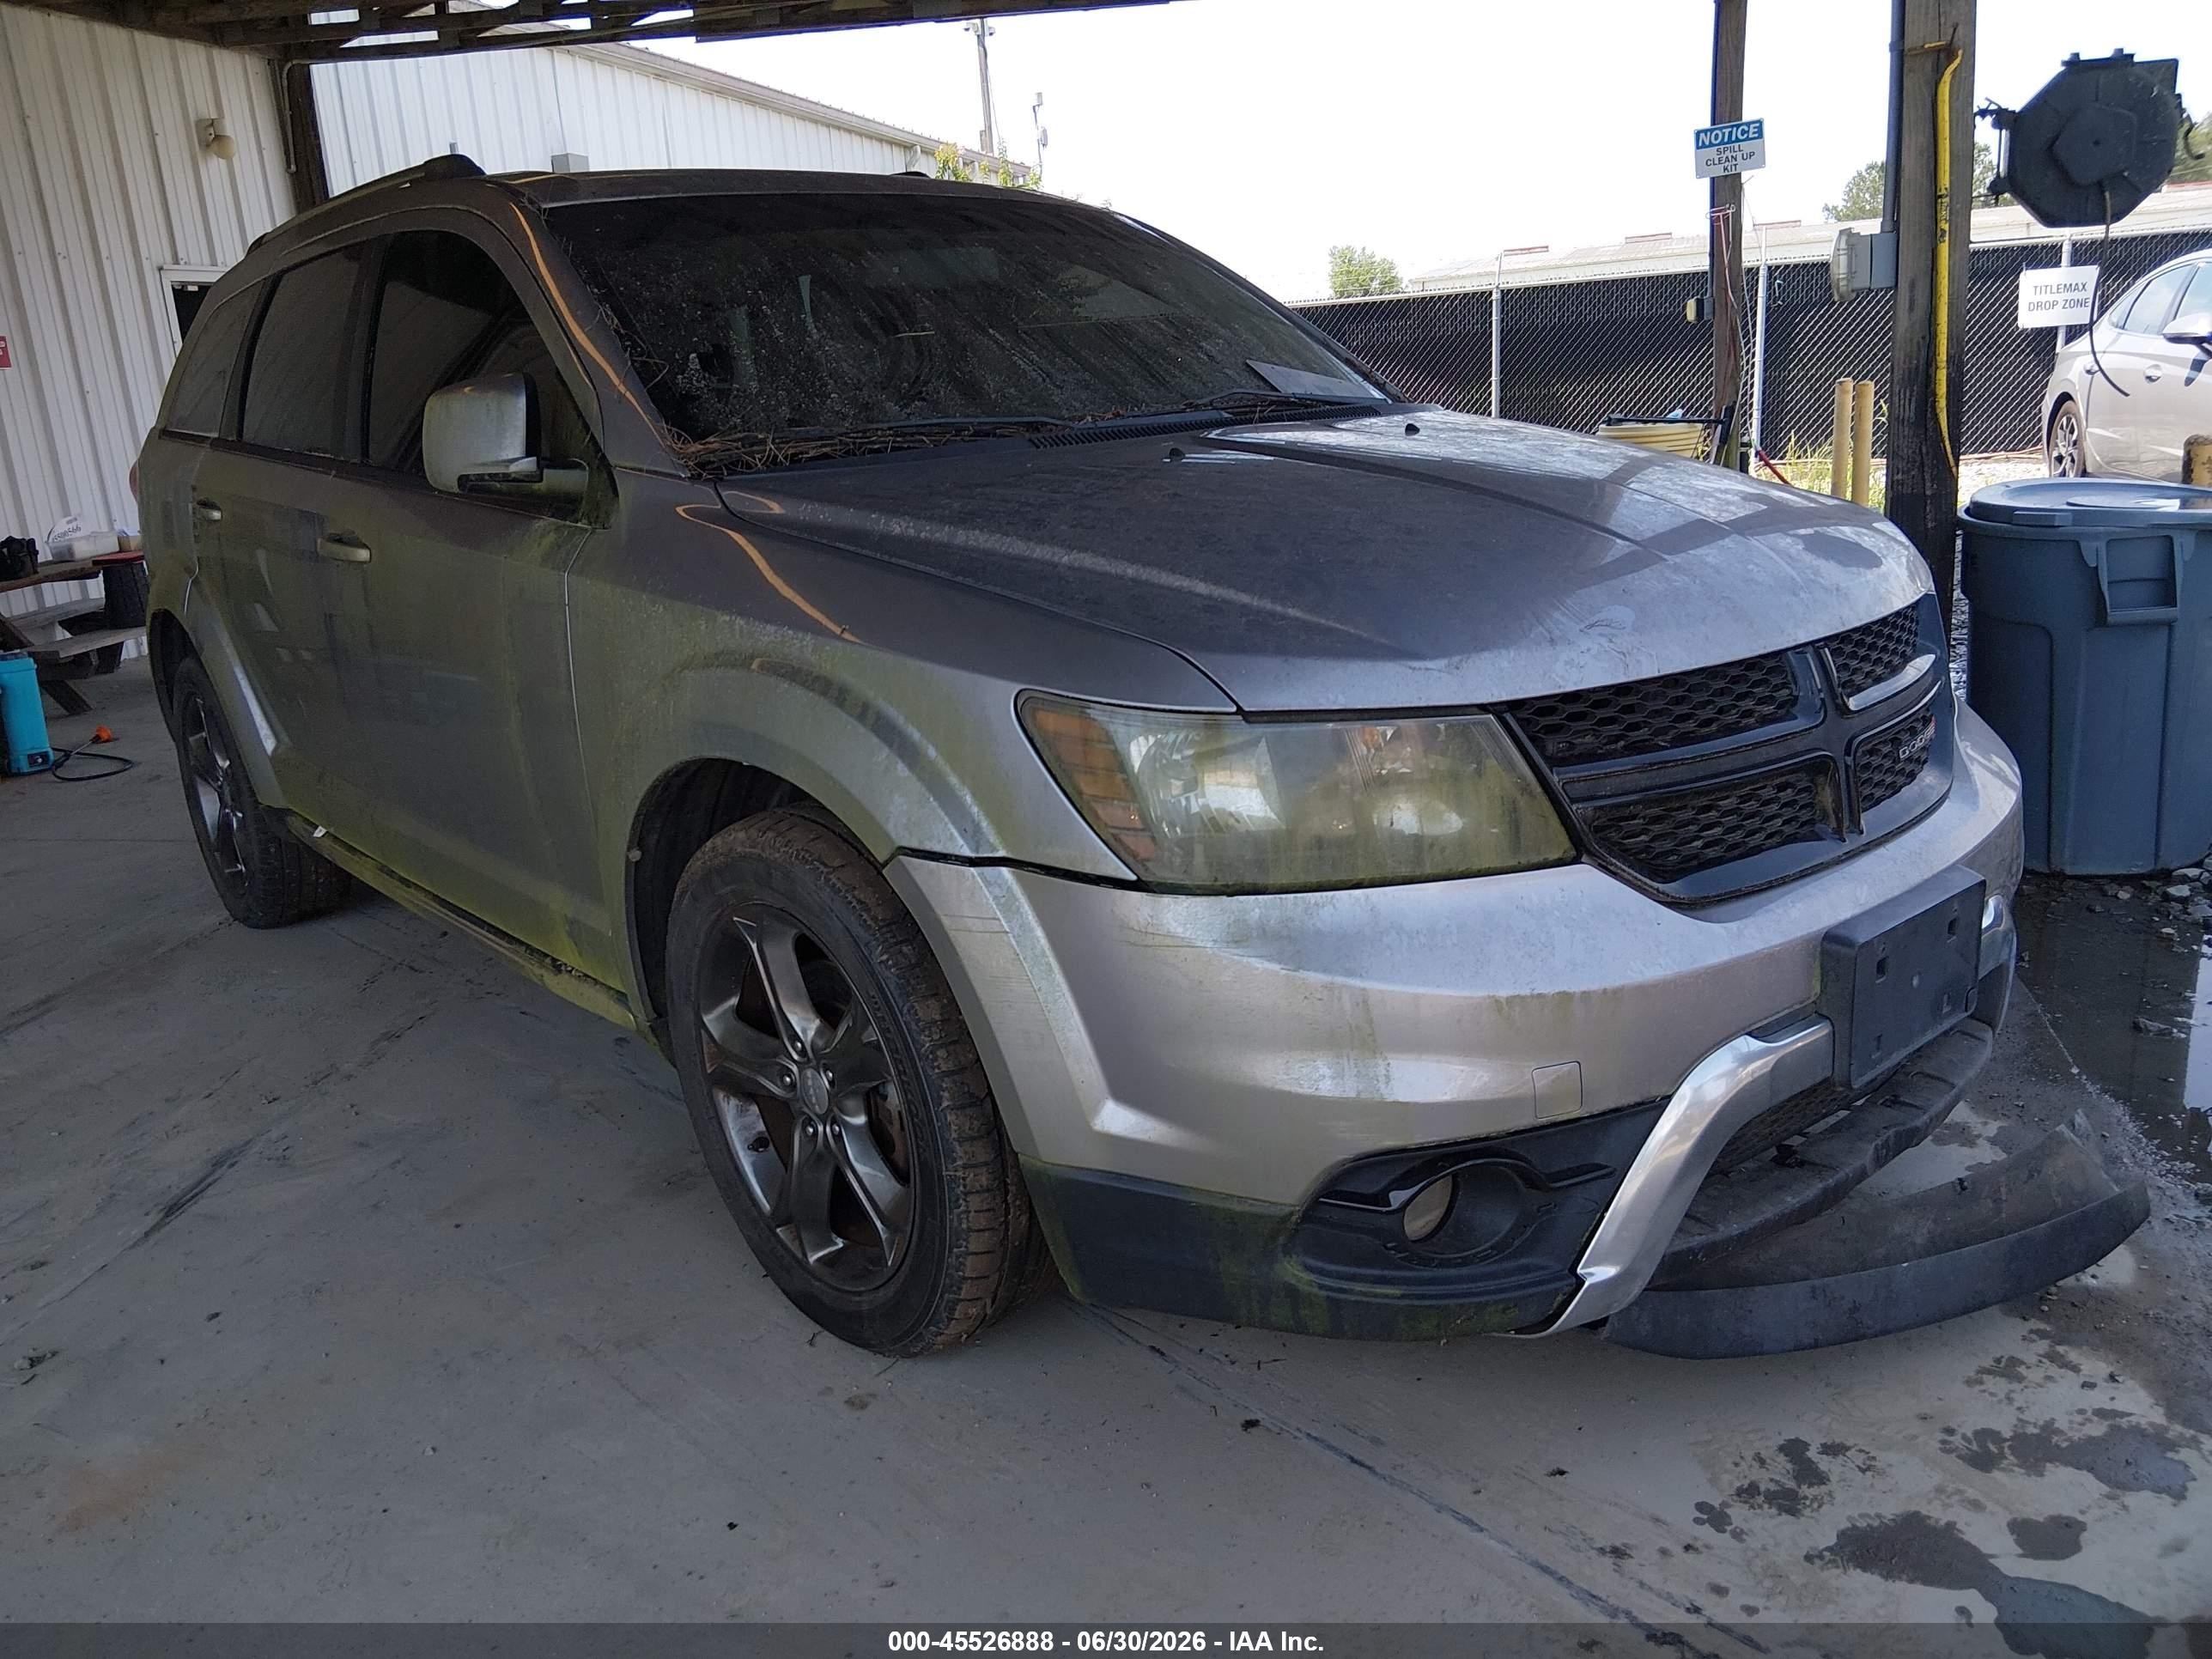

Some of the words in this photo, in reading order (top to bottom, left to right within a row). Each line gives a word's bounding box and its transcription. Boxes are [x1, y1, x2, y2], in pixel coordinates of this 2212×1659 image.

[1698, 123, 1760, 147] NOTICE
[1716, 144, 1744, 155] SPILL
[1705, 155, 1738, 167] CLEAN
[1741, 151, 1755, 161] UP
[1723, 163, 1739, 173] KIT
[2033, 282, 2088, 295] TITLEMAX
[2028, 300, 2059, 312] DROP
[2062, 297, 2090, 310] ZONE
